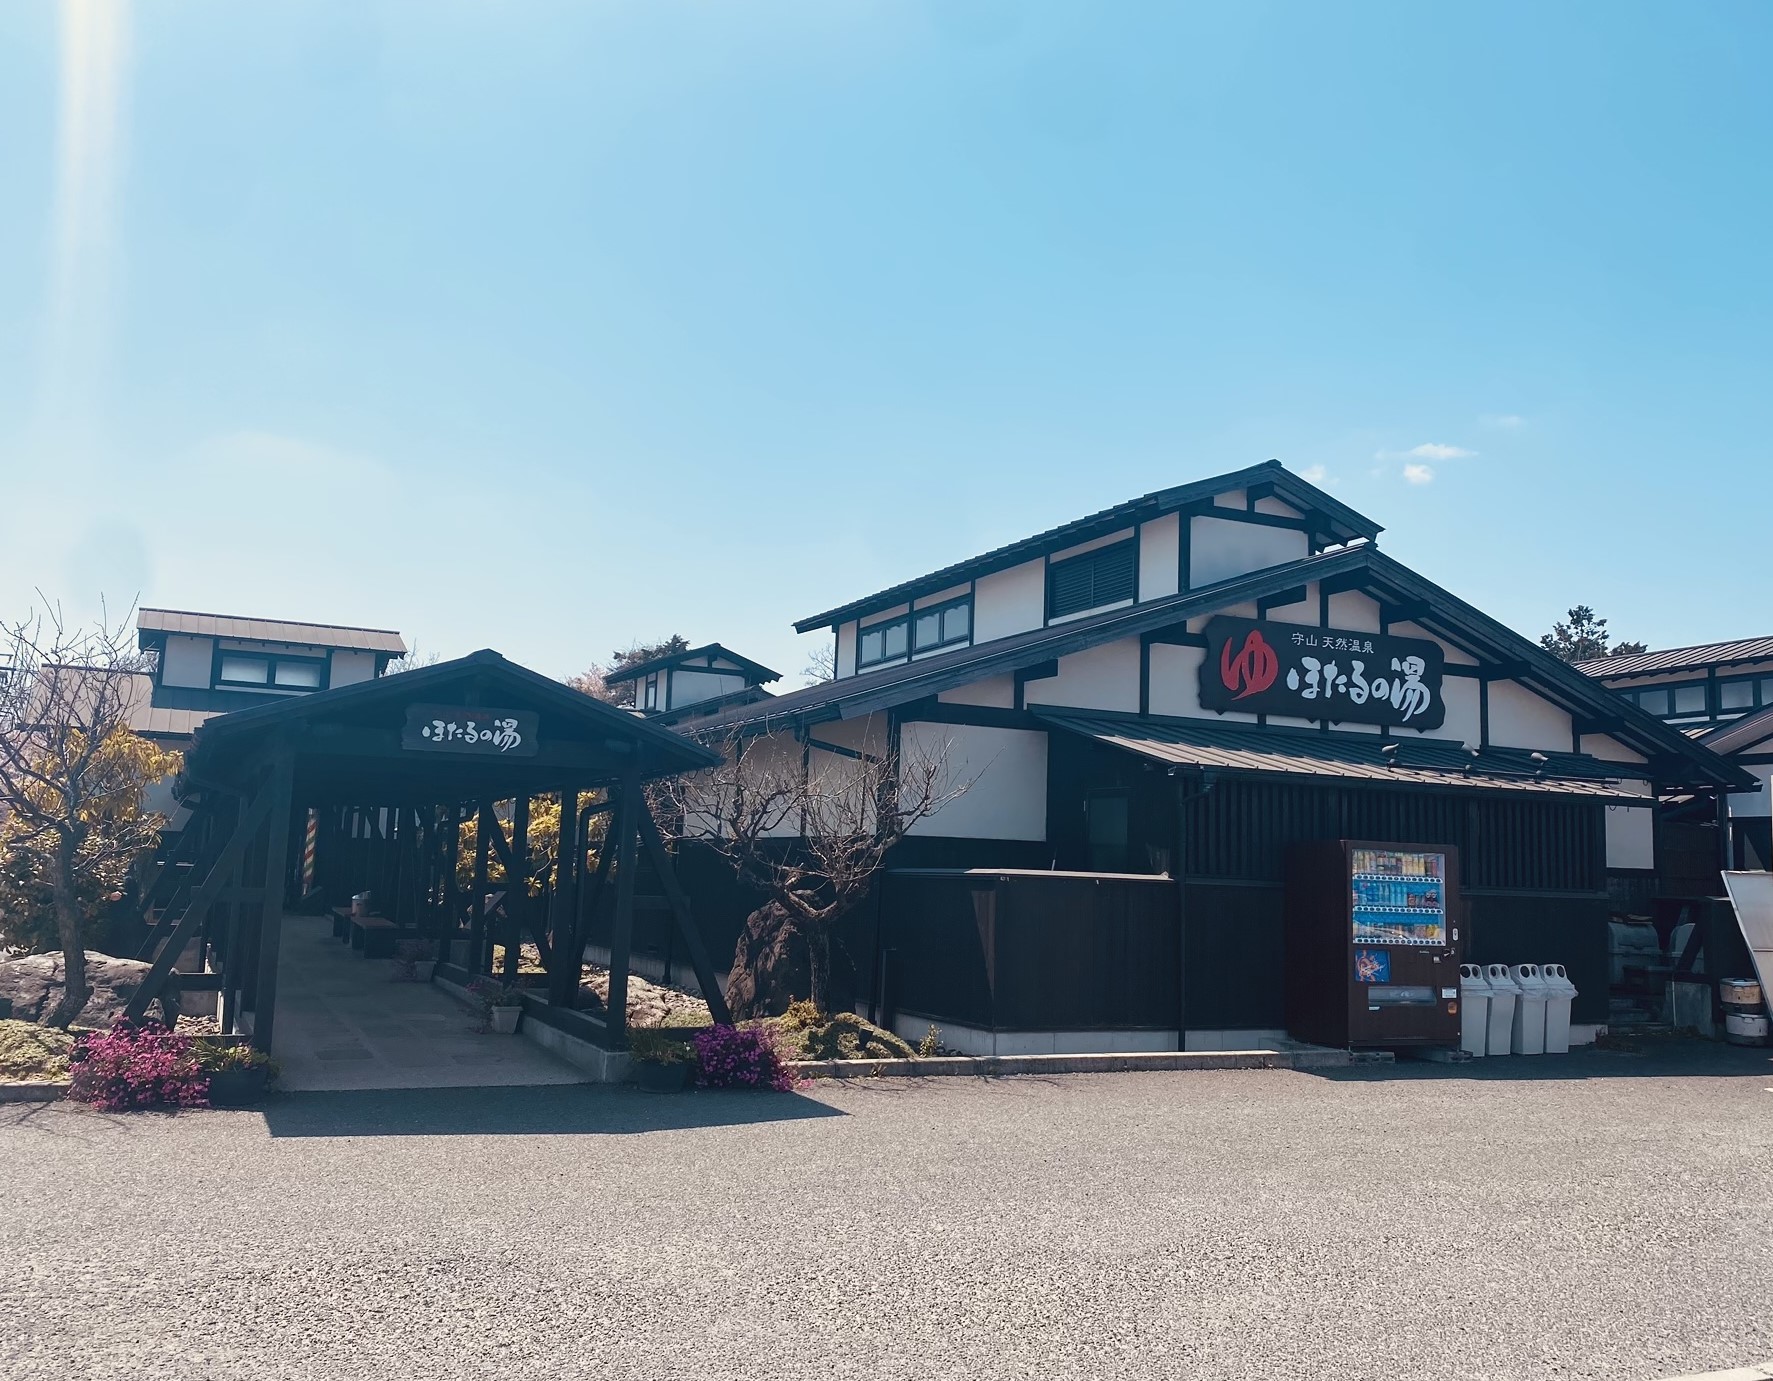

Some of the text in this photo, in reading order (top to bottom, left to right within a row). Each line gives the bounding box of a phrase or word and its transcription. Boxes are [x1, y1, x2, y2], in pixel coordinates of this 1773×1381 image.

[1220, 630, 1279, 700] ゆ
[1291, 632, 1375, 654] 守山 天然温泉
[1286, 655, 1431, 722] ほたるの湯
[422, 718, 522, 753] ほたるの湯
